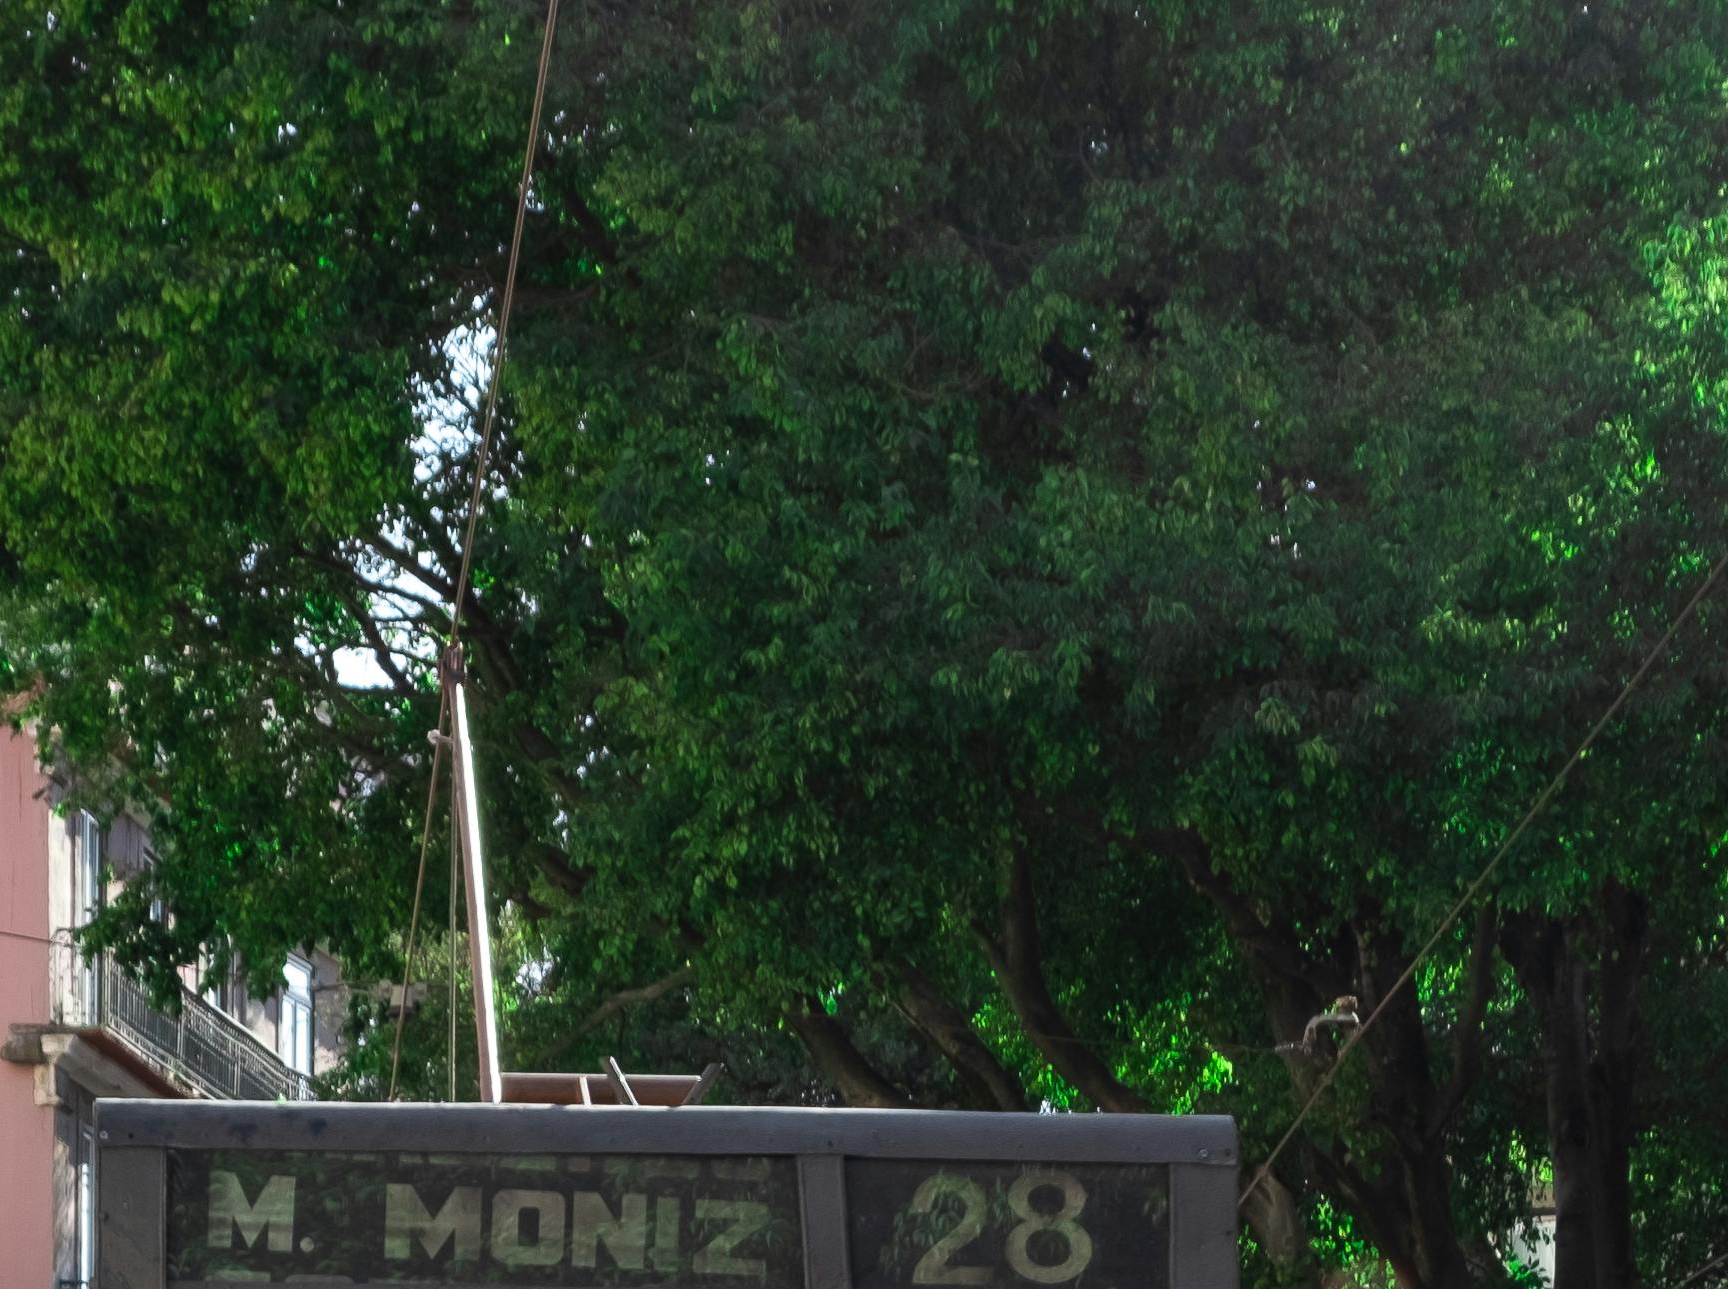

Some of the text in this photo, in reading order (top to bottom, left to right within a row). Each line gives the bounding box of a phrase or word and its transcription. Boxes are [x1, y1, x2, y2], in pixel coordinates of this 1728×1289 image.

[208, 1170, 1093, 1285] M. MONIZ 28
